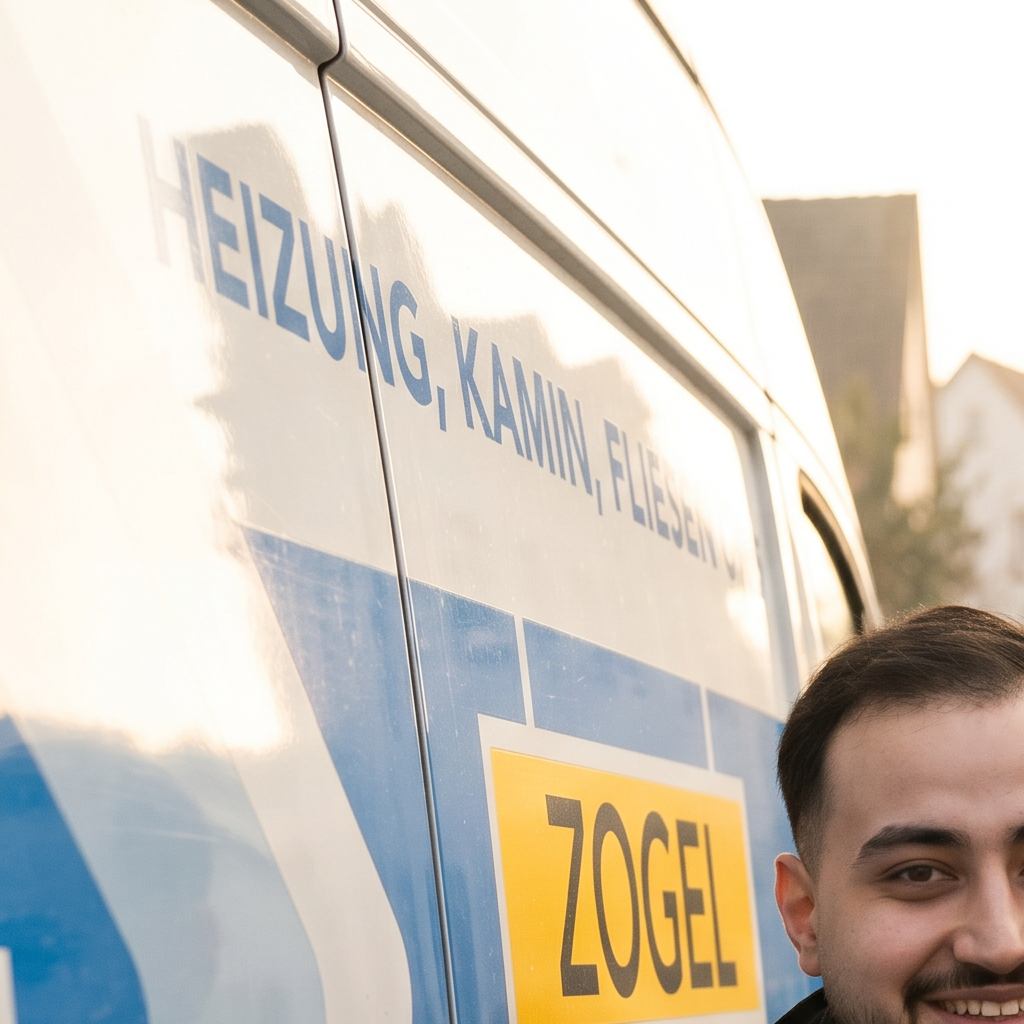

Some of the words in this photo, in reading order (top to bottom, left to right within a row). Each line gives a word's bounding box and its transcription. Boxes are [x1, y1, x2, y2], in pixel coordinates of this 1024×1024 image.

[136, 113, 447, 433] HEIZUNG,
[451, 314, 603, 516] KAMIN,
[545, 794, 738, 998] ZOGEL
